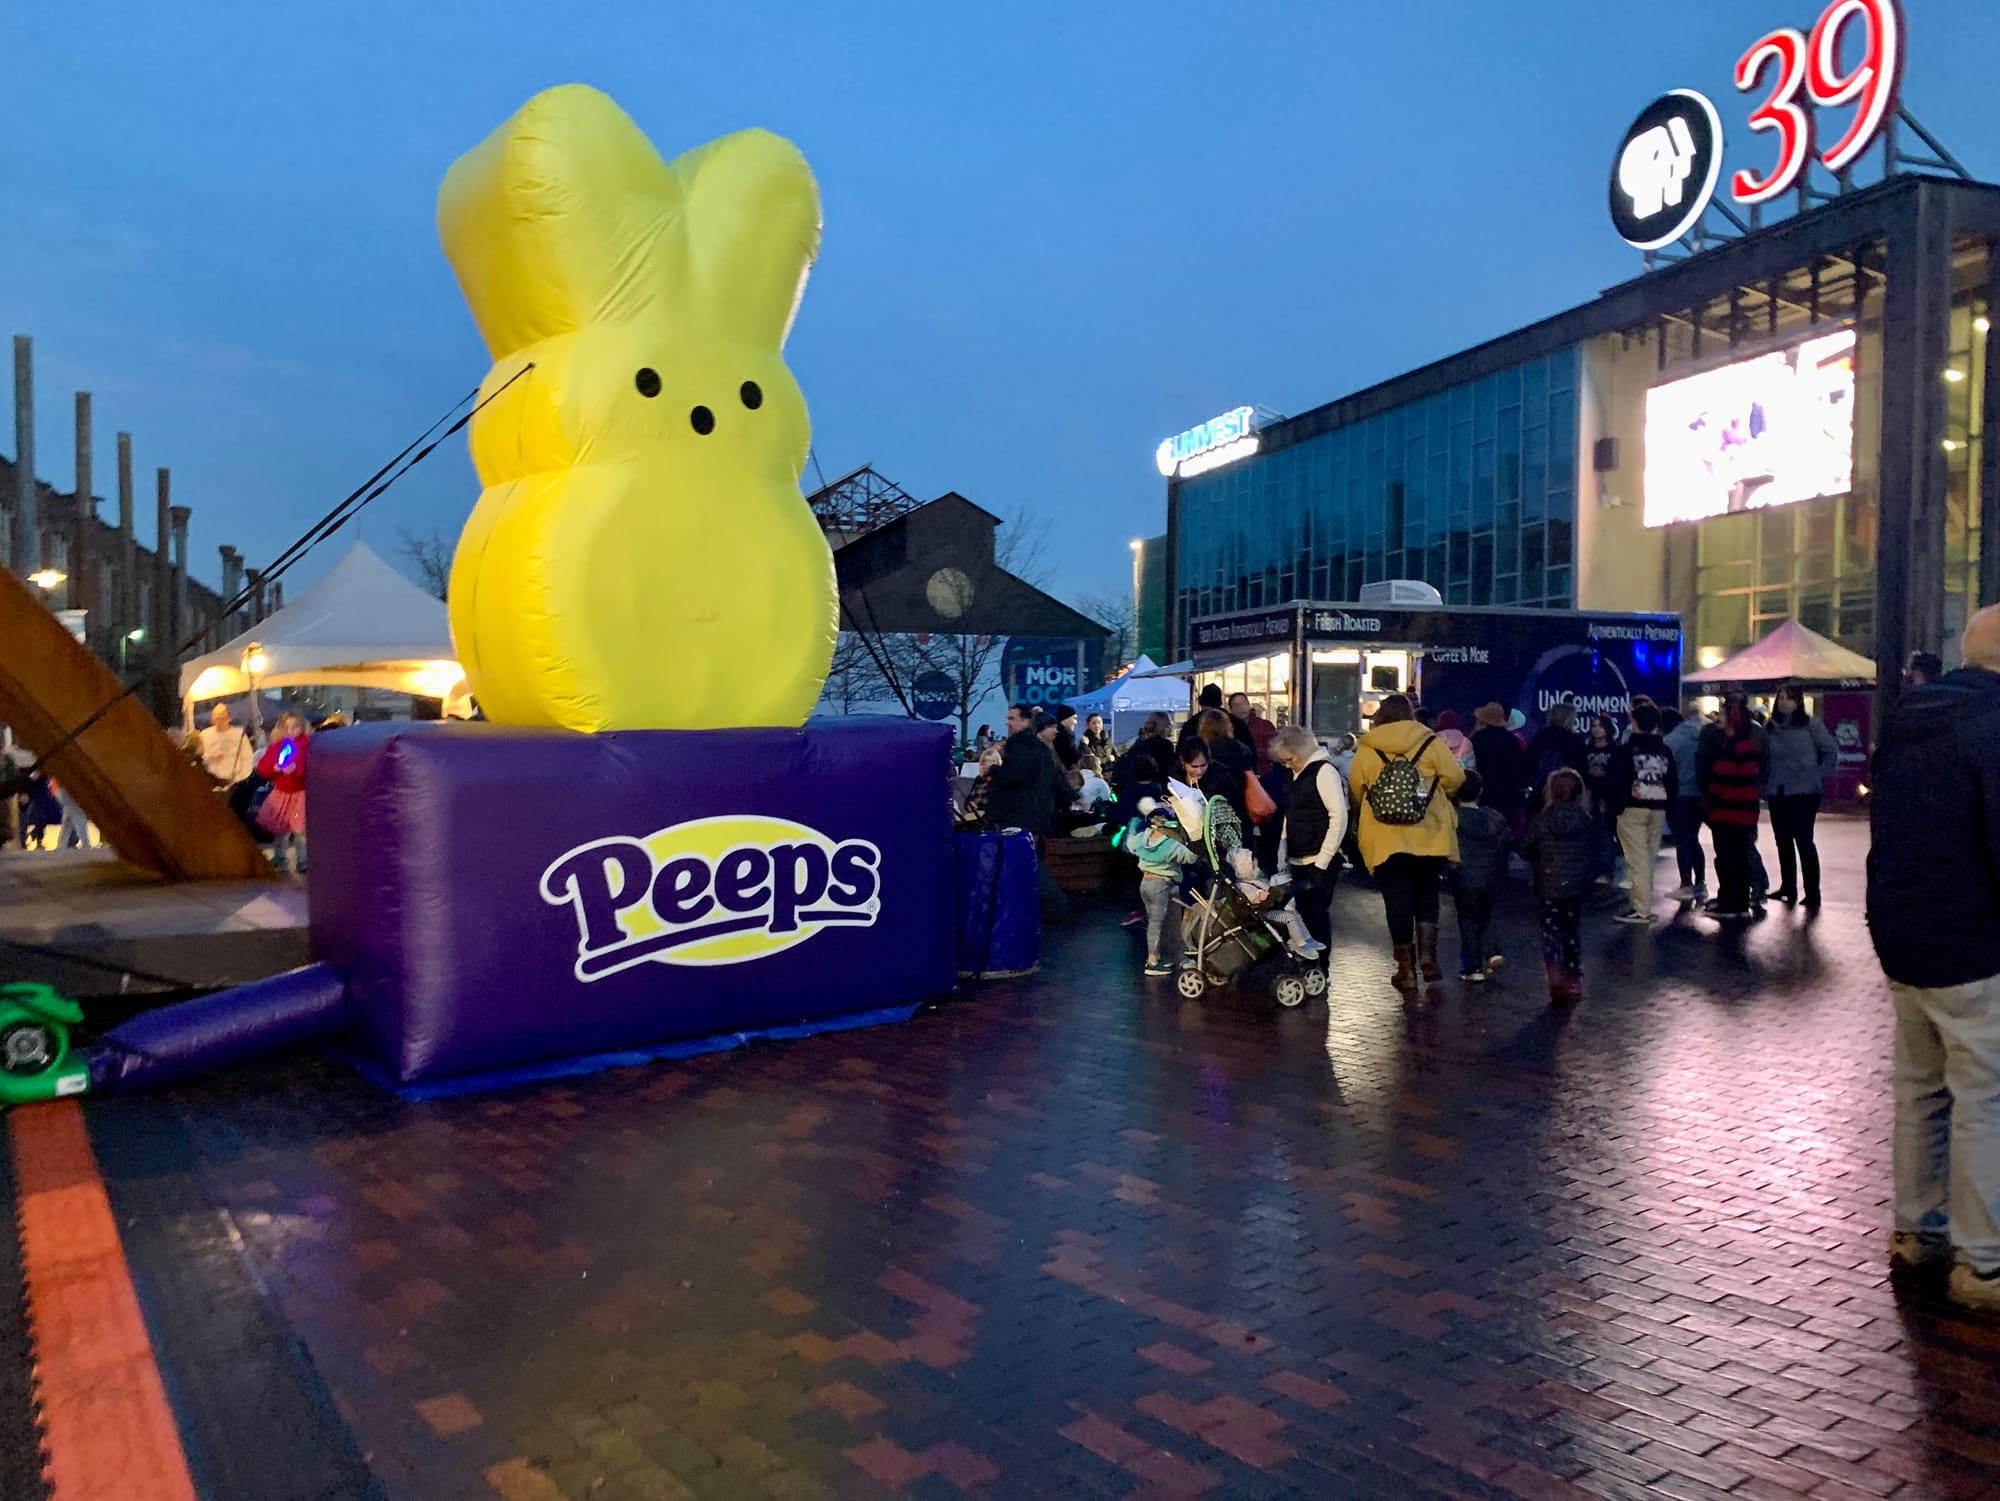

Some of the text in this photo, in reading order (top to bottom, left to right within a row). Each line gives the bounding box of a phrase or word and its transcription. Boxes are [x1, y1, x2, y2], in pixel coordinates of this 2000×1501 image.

[1732, 0, 1898, 204] 39
[1315, 613, 1381, 632] FRESH ROASTED
[1470, 647, 1489, 663] MORE
[1014, 685, 1073, 704] LOCA
[540, 835, 881, 955] Peeps
